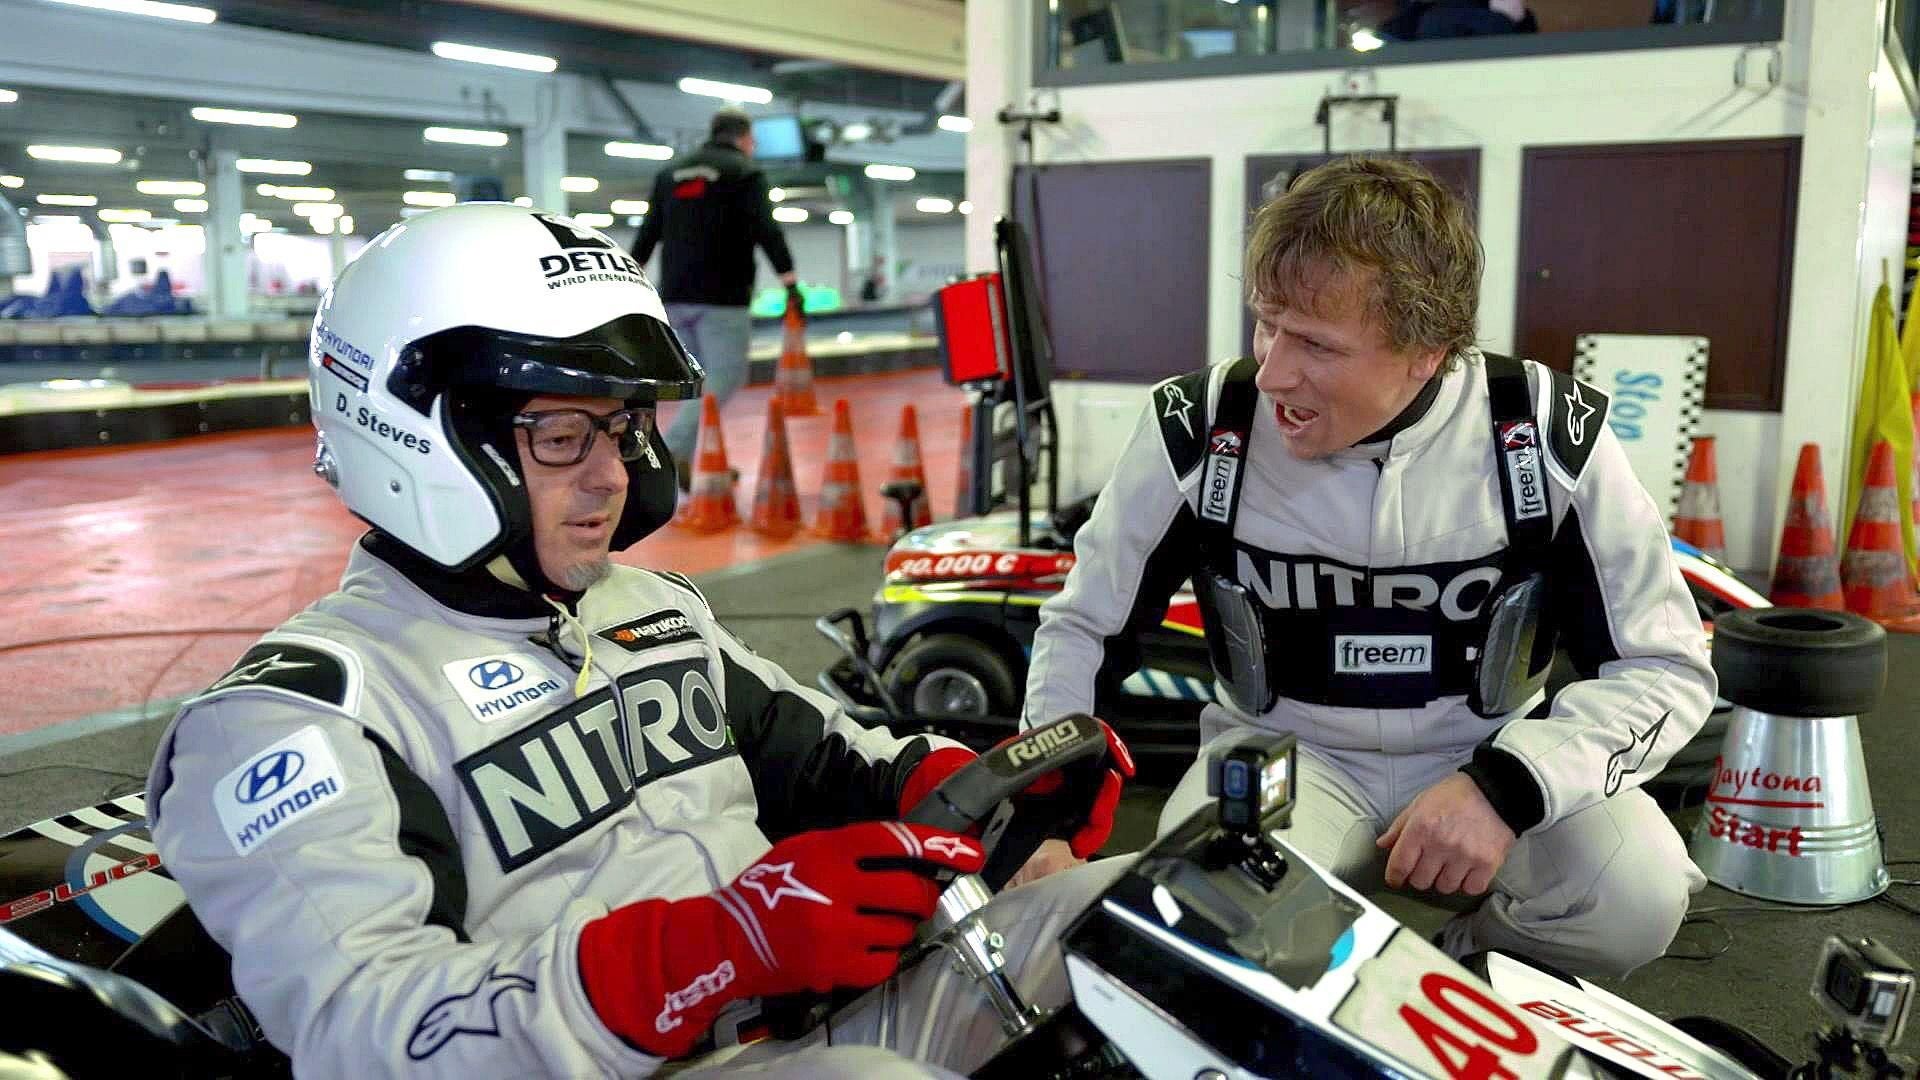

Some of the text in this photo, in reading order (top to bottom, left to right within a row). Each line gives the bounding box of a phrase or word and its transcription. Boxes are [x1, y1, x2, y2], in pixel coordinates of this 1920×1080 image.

[539, 251, 645, 278] DETLE
[547, 275, 587, 289] WIRD
[336, 391, 431, 454] D. Steves
[1610, 369, 1663, 440] Stop
[1206, 457, 1231, 517] freem
[1517, 451, 1544, 515] freem
[1236, 550, 1502, 622] NITRO
[1341, 640, 1427, 667] freem
[476, 679, 560, 718] HYUNDAI
[470, 669, 727, 858] NITRO
[236, 776, 338, 848] HYUNDAI
[1709, 806, 1803, 857] Start
[1398, 972, 1539, 1080] 40
